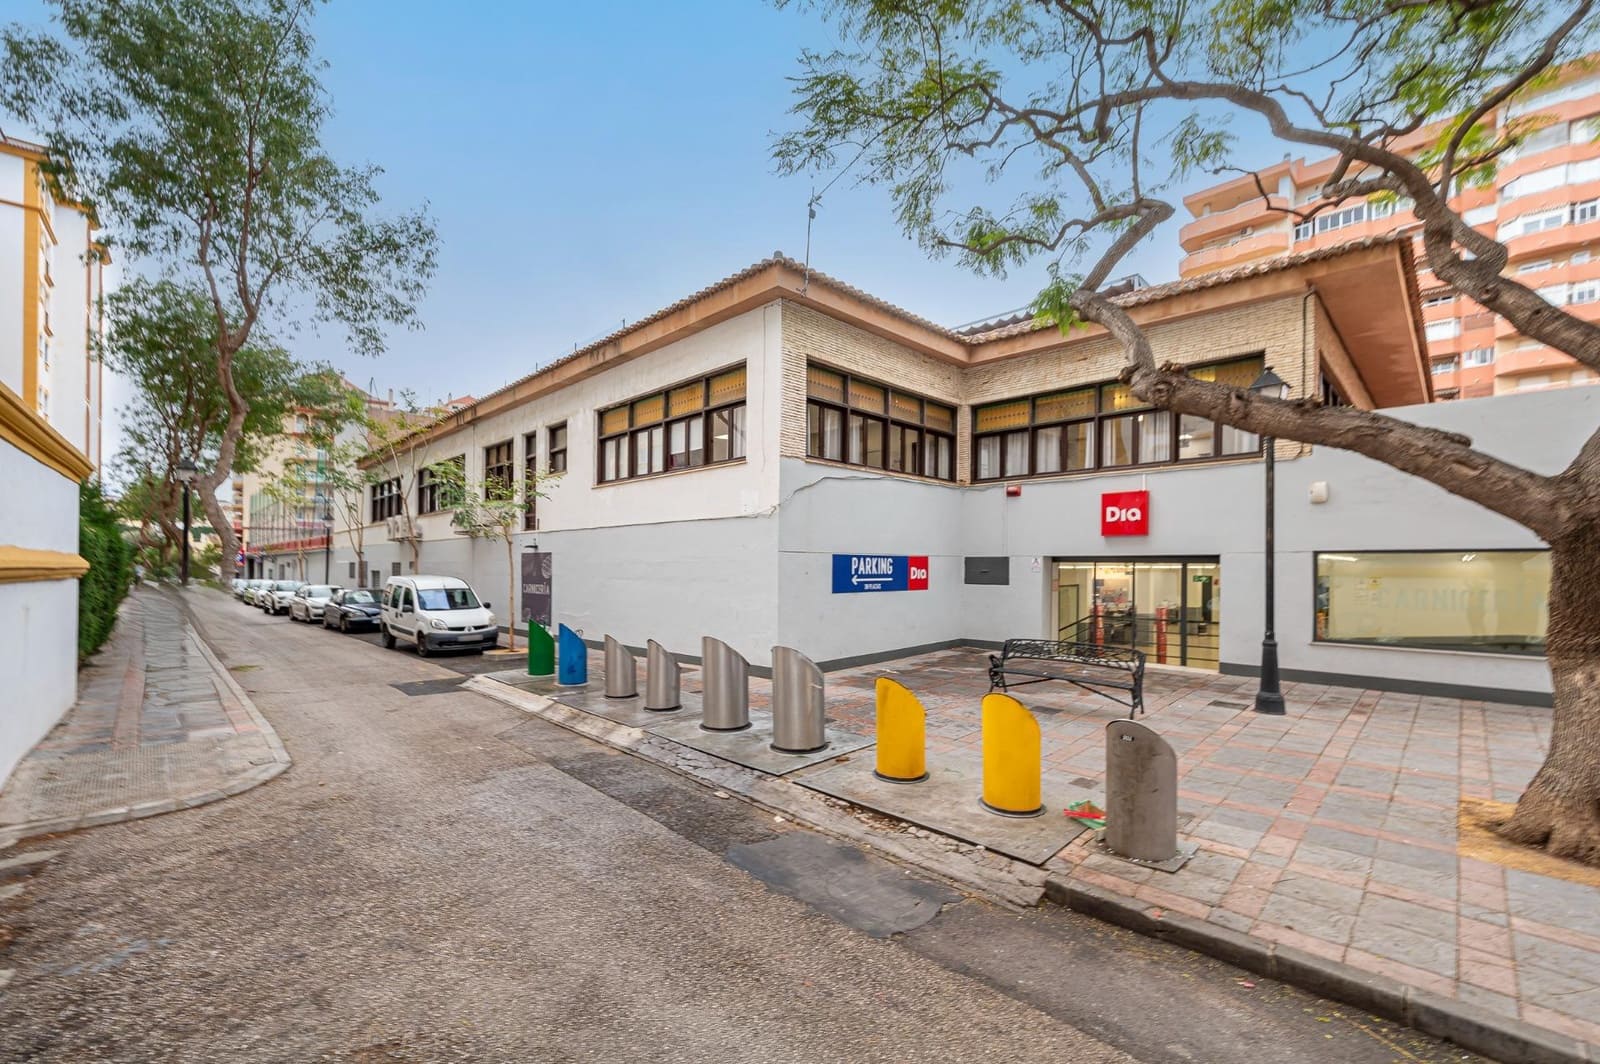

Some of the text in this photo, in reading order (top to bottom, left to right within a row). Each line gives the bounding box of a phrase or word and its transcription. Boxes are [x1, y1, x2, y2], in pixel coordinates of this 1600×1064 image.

[1105, 506, 1142, 523] Dia
[851, 557, 893, 575] PARKING
[910, 566, 927, 580] Dia
